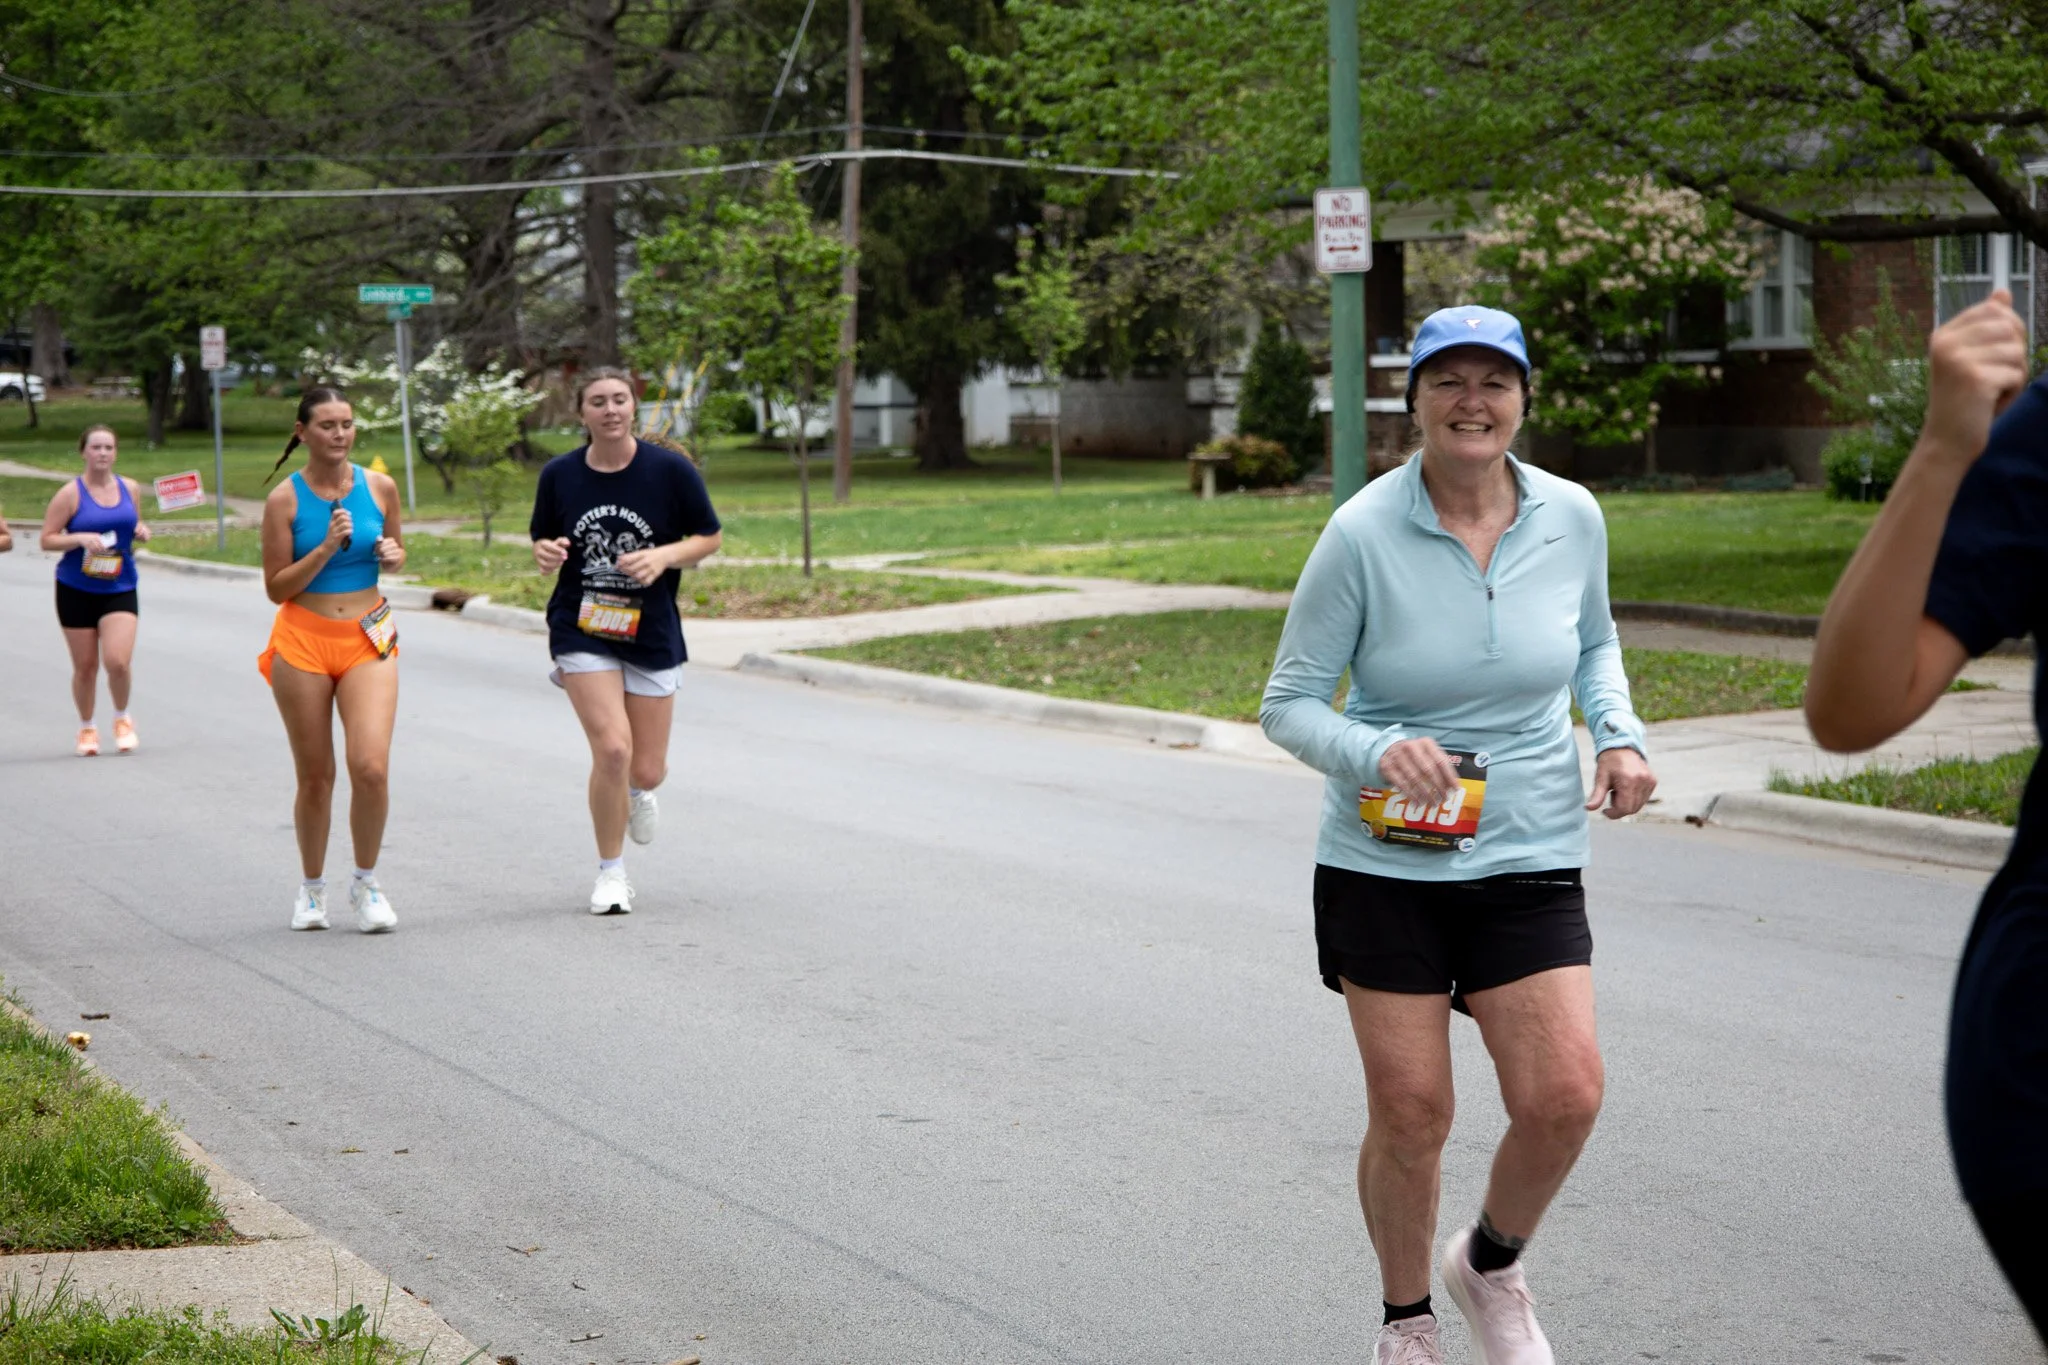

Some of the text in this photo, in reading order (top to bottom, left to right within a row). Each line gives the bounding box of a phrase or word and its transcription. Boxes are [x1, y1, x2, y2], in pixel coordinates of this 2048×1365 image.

[1331, 196, 1352, 212] NO
[1318, 214, 1367, 229] PARKING
[573, 504, 654, 538] POTTER'S HOUSE
